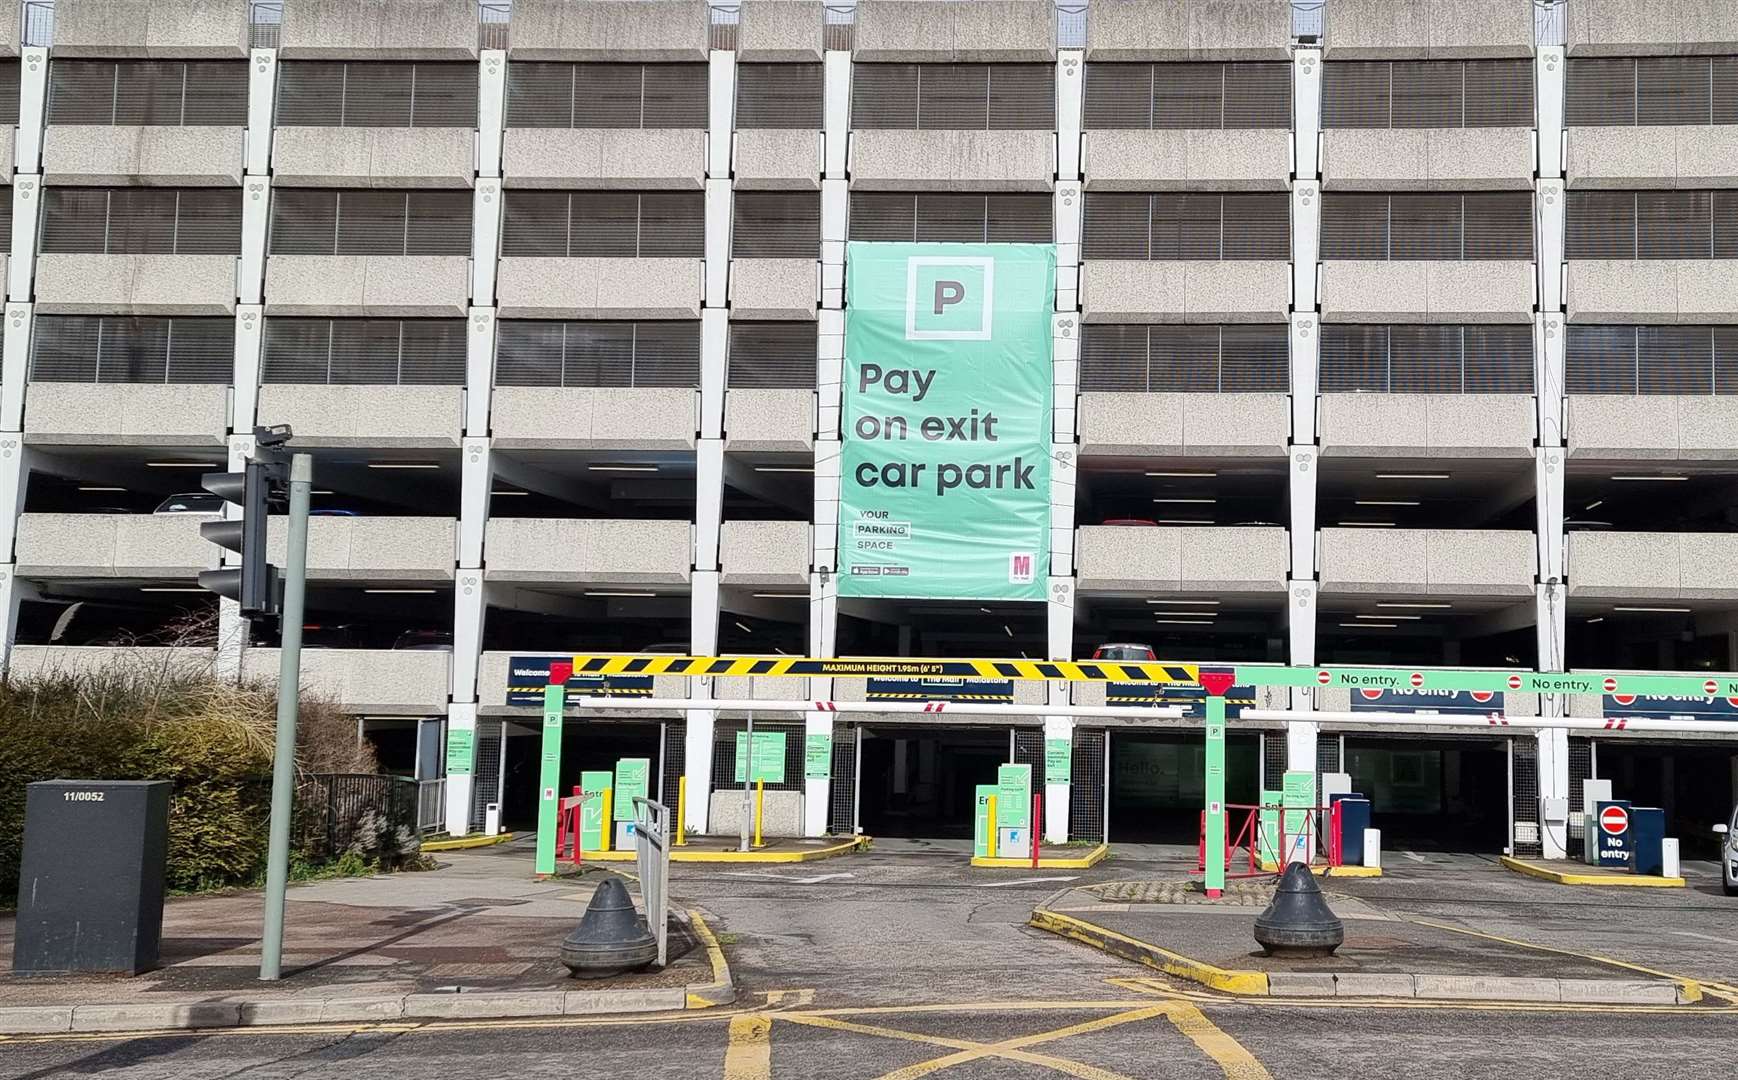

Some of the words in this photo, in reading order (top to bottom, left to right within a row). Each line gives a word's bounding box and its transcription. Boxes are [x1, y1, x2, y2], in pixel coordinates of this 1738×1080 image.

[934, 280, 965, 315] P
[858, 363, 936, 402] Pay
[855, 415, 907, 441] on
[920, 408, 998, 441] exit
[855, 462, 926, 488] car
[936, 457, 1036, 497] park
[860, 511, 889, 519] YOUR
[857, 525, 906, 535] PARKING
[857, 541, 893, 550] SPACE
[1013, 555, 1030, 576] M
[514, 669, 551, 677] Welcome
[822, 663, 865, 672] MAXIMUM
[866, 664, 895, 672] HEIGHT
[897, 664, 919, 673] 1.95m
[1341, 674, 1359, 685] No
[1362, 675, 1400, 687] entry.
[1532, 679, 1551, 689] No
[1554, 680, 1593, 692] entry.
[64, 792, 105, 802] 11/0052
[1607, 837, 1623, 847] No
[1601, 849, 1630, 861] entry
